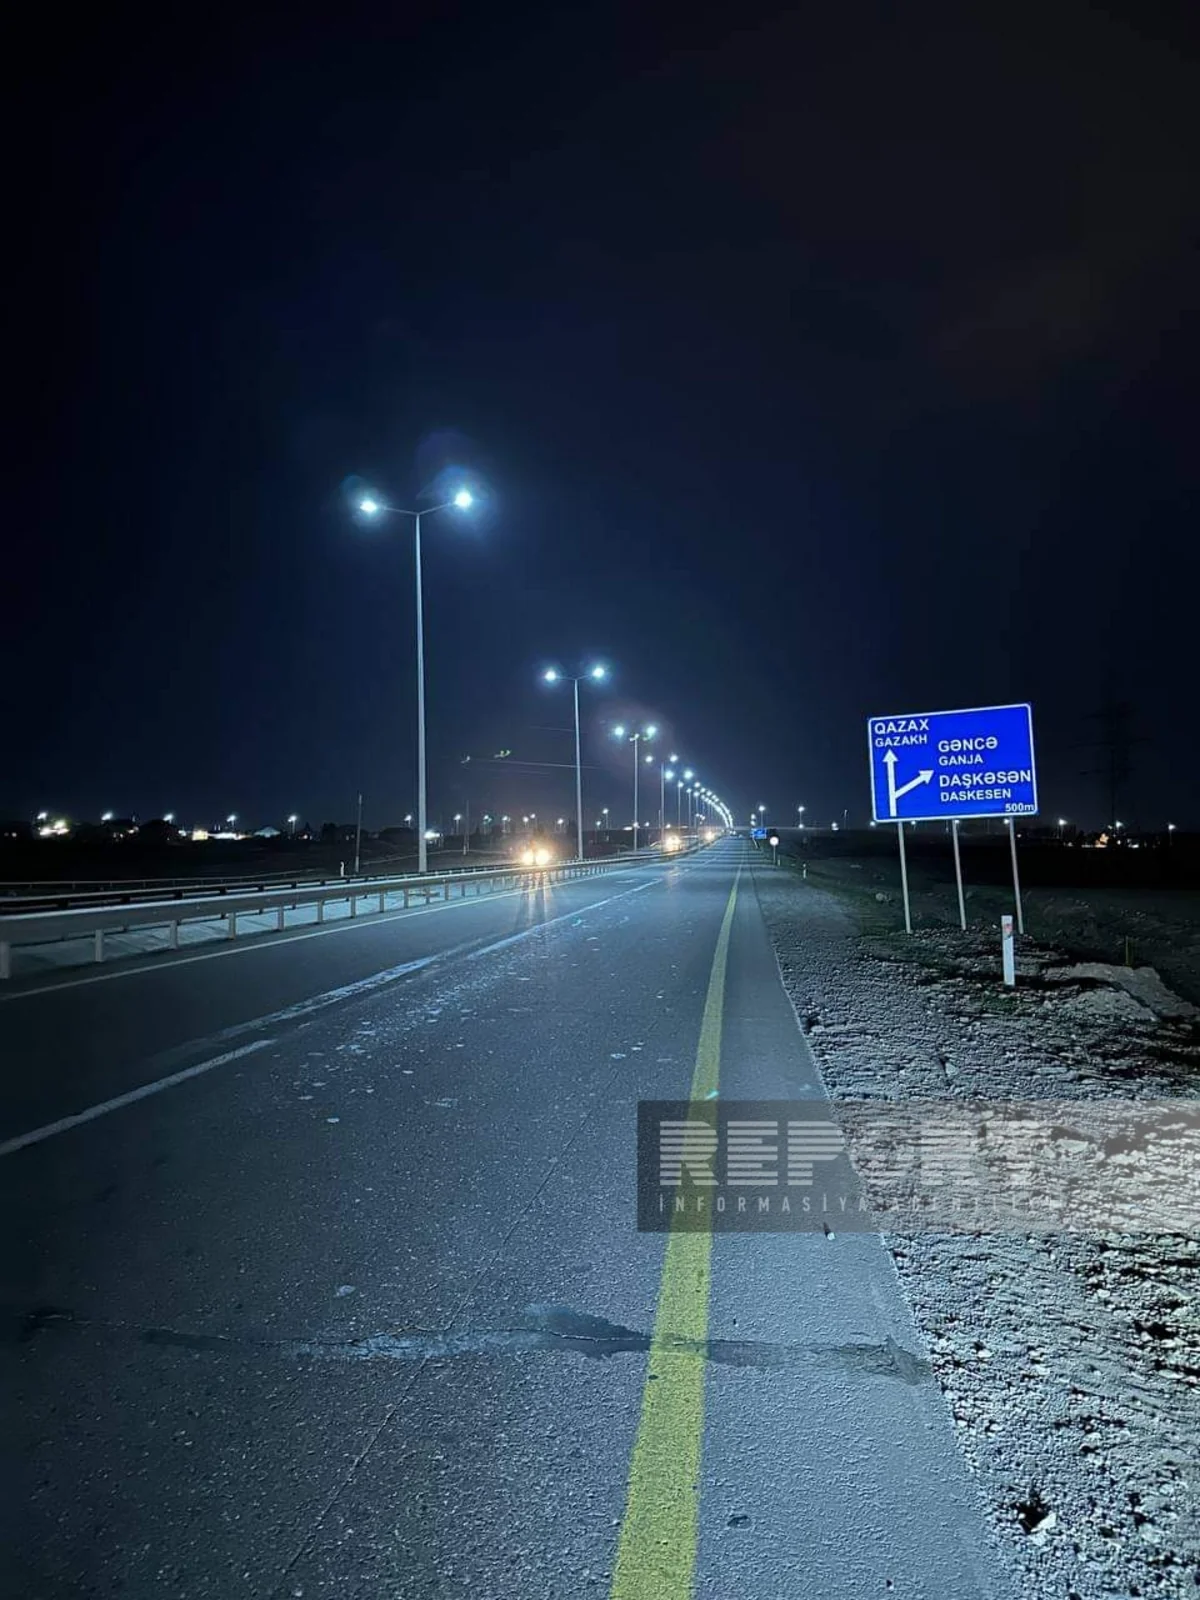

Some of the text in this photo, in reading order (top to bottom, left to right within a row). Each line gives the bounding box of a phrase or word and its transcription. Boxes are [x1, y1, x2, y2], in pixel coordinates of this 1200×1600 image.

[874, 718, 930, 735] QAZAX
[875, 734, 928, 748] GAZAKH
[938, 736, 998, 753] GƏNCƏ
[939, 754, 983, 766] GANJA
[939, 769, 1031, 789] DAŞKƏSƏN
[940, 788, 1011, 802] DASKESEN
[1005, 803, 1035, 812] 500m
